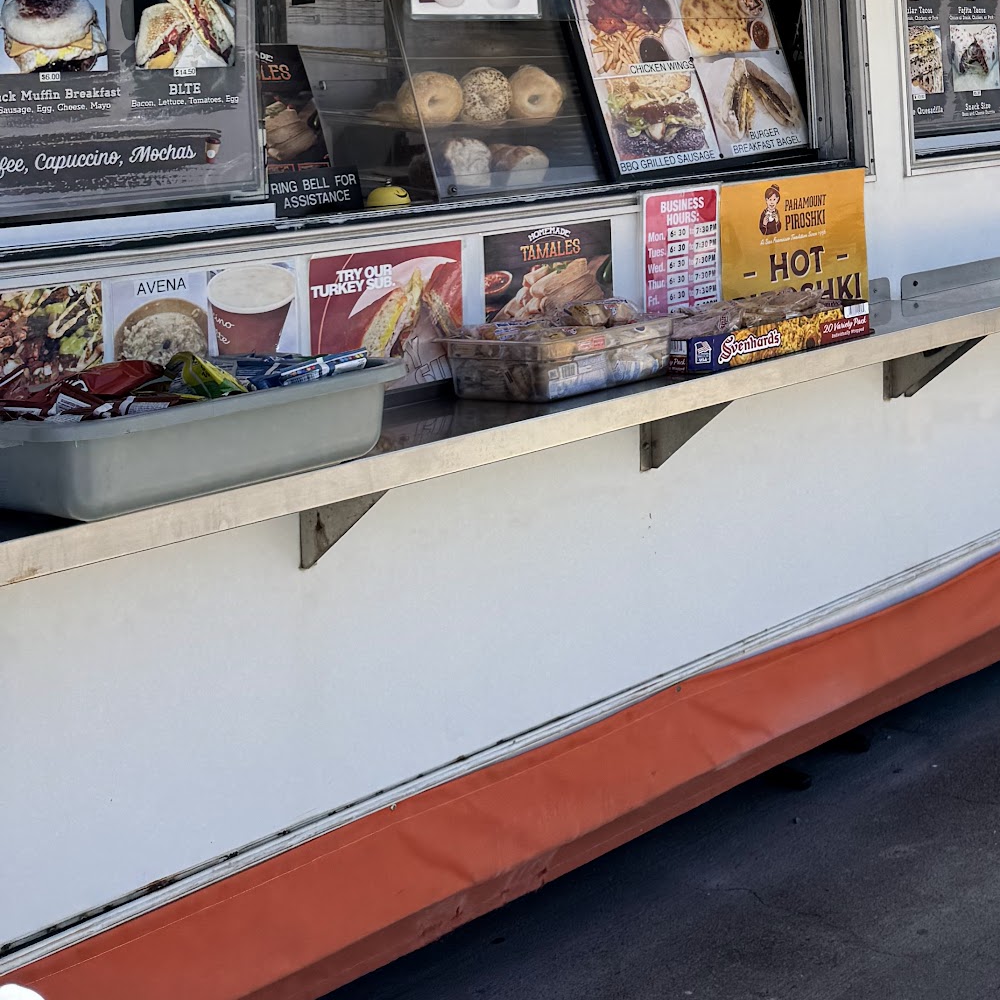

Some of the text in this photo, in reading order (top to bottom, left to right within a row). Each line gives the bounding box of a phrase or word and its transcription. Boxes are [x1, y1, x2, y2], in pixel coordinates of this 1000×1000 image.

[629, 60, 695, 74] CHICKEN WINGS
[20, 87, 121, 101] Muffin Breakfast
[168, 83, 201, 95] BLTE
[90, 102, 112, 110] Mayo
[226, 95, 239, 103] Egg
[750, 127, 780, 139] BURGER
[732, 136, 801, 154] BREAKFAST BAGEL
[35, 143, 196, 174] Capuccino, Mochas
[620, 150, 716, 172] BBQ GRILLED SAUSAGE
[271, 173, 357, 195] RING BELL FOR
[284, 189, 351, 209] ASSISTANCE
[660, 196, 704, 214] BUSINESS
[784, 194, 826, 212] PARAMOUNT
[667, 212, 699, 226] HOURS:
[785, 209, 826, 231] PIROSHKI
[528, 227, 571, 242] HOMEMADE
[520, 238, 581, 262] TAMALES
[770, 245, 825, 283] HOT
[336, 264, 393, 284] TRY OUR
[136, 277, 187, 296] AVENA
[310, 276, 396, 299] TURKEY SUB.
[823, 323, 833, 334] 20
[853, 316, 867, 326] Pack
[718, 330, 781, 364] Svenhard's
